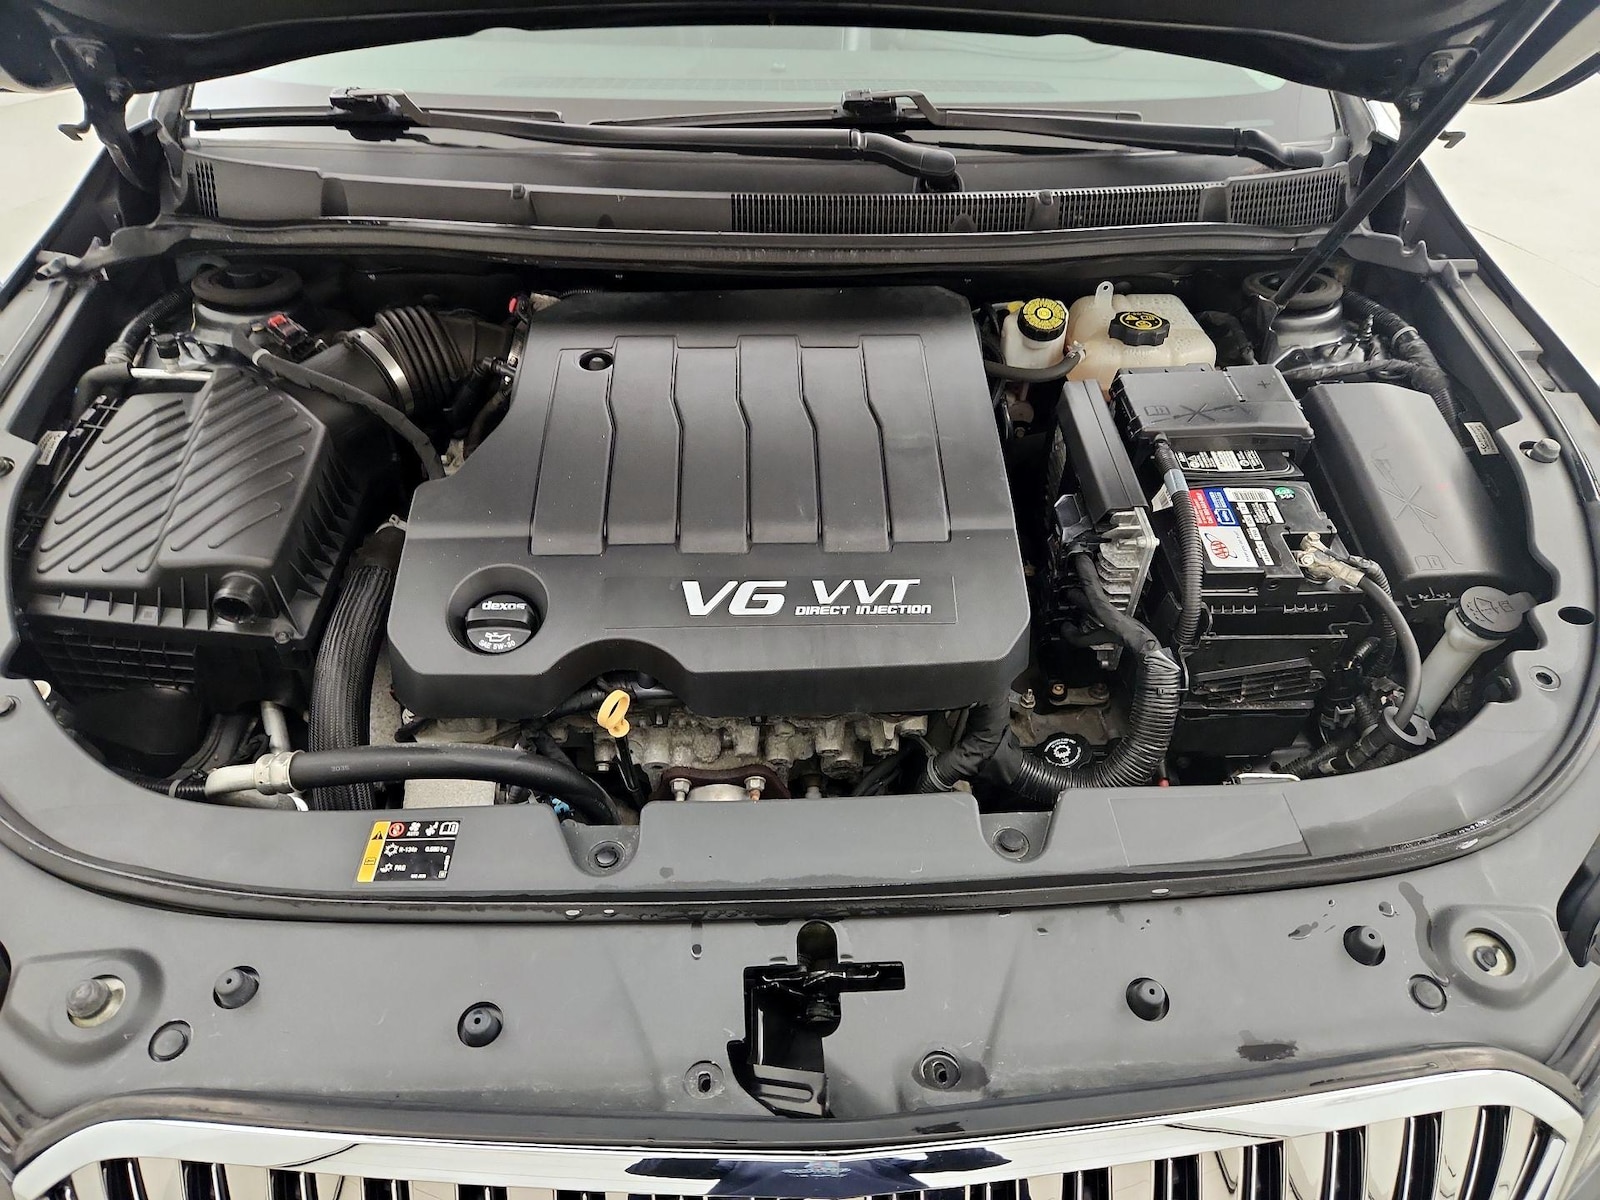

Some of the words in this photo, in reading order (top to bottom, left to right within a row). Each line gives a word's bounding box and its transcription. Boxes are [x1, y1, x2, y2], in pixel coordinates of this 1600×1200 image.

[681, 580, 788, 616] V6
[811, 579, 921, 605] VVT
[481, 601, 528, 611] dexos
[795, 605, 851, 616] DIRECT
[855, 604, 932, 615] INJECTION
[478, 639, 492, 650] SAE
[492, 640, 516, 650] 5W-30
